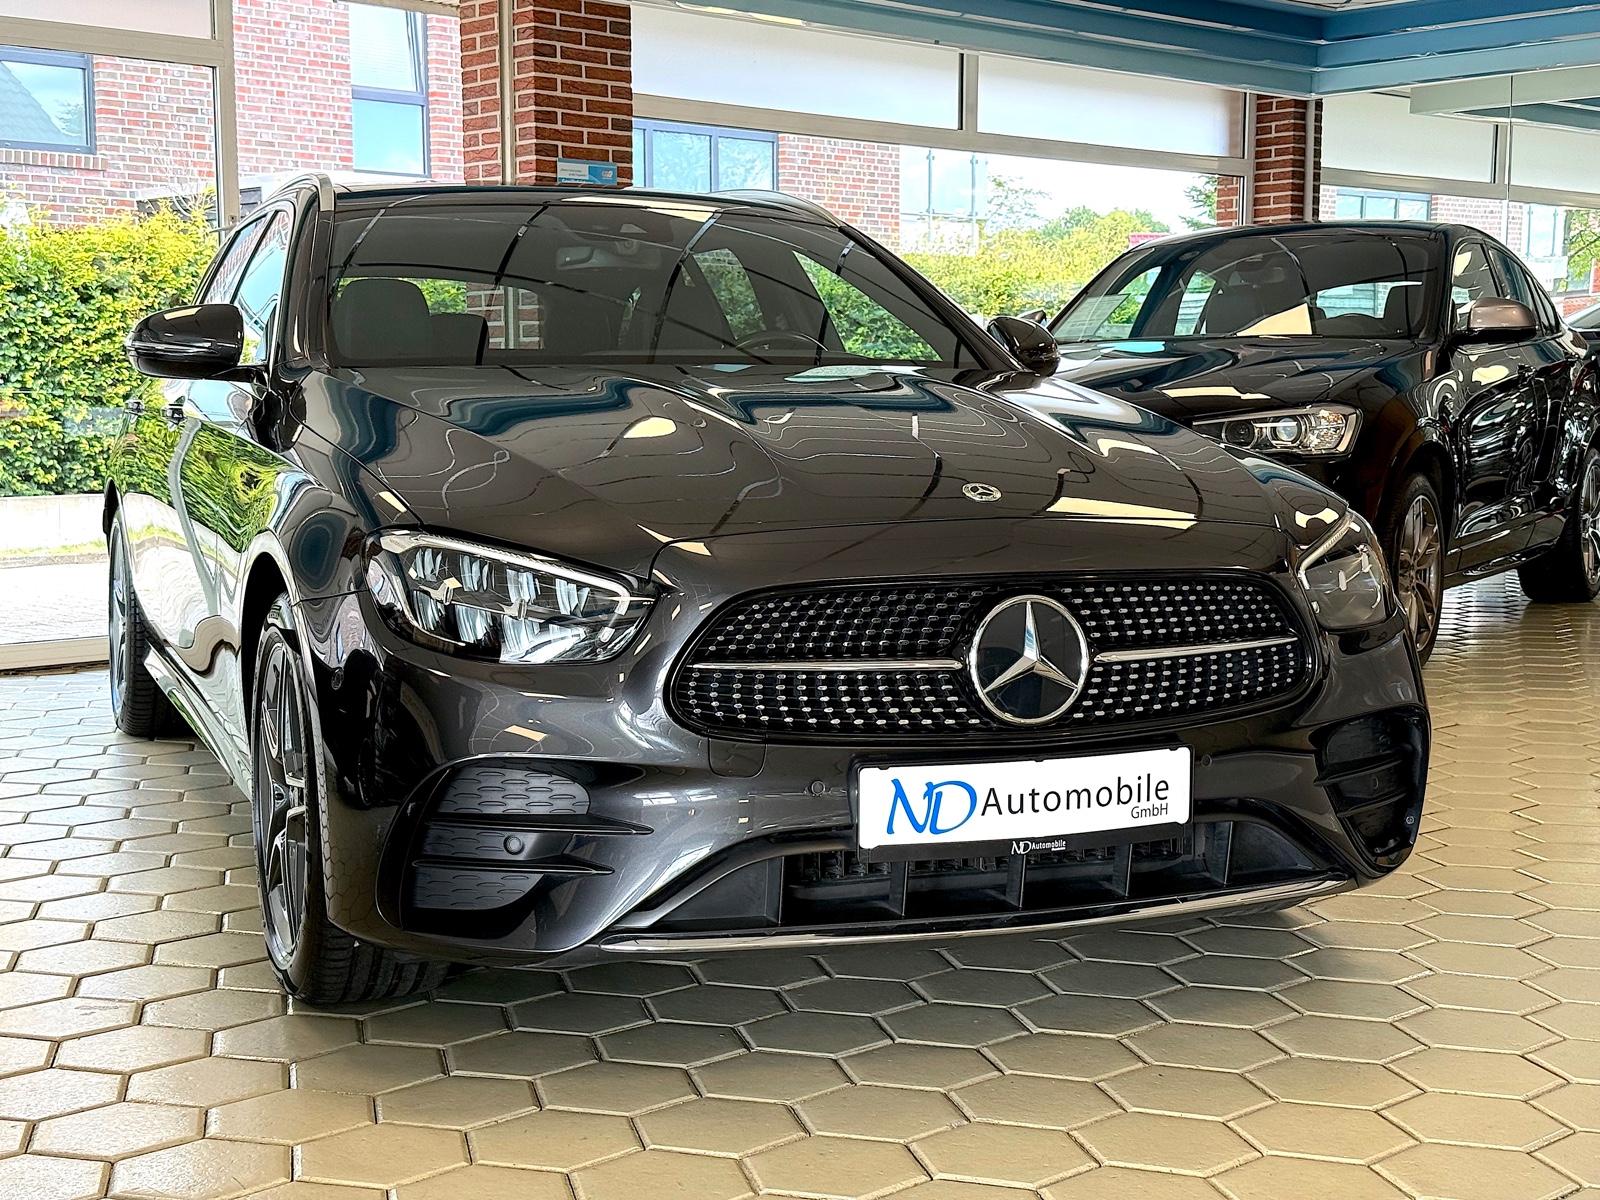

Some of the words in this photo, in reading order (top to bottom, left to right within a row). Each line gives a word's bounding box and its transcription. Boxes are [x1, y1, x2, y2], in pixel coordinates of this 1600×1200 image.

[887, 778, 978, 835] ND
[981, 773, 1170, 817] Automobile
[1130, 803, 1169, 819] GmbH
[1011, 840, 1031, 855] ND
[1031, 839, 1066, 850] Automobile
